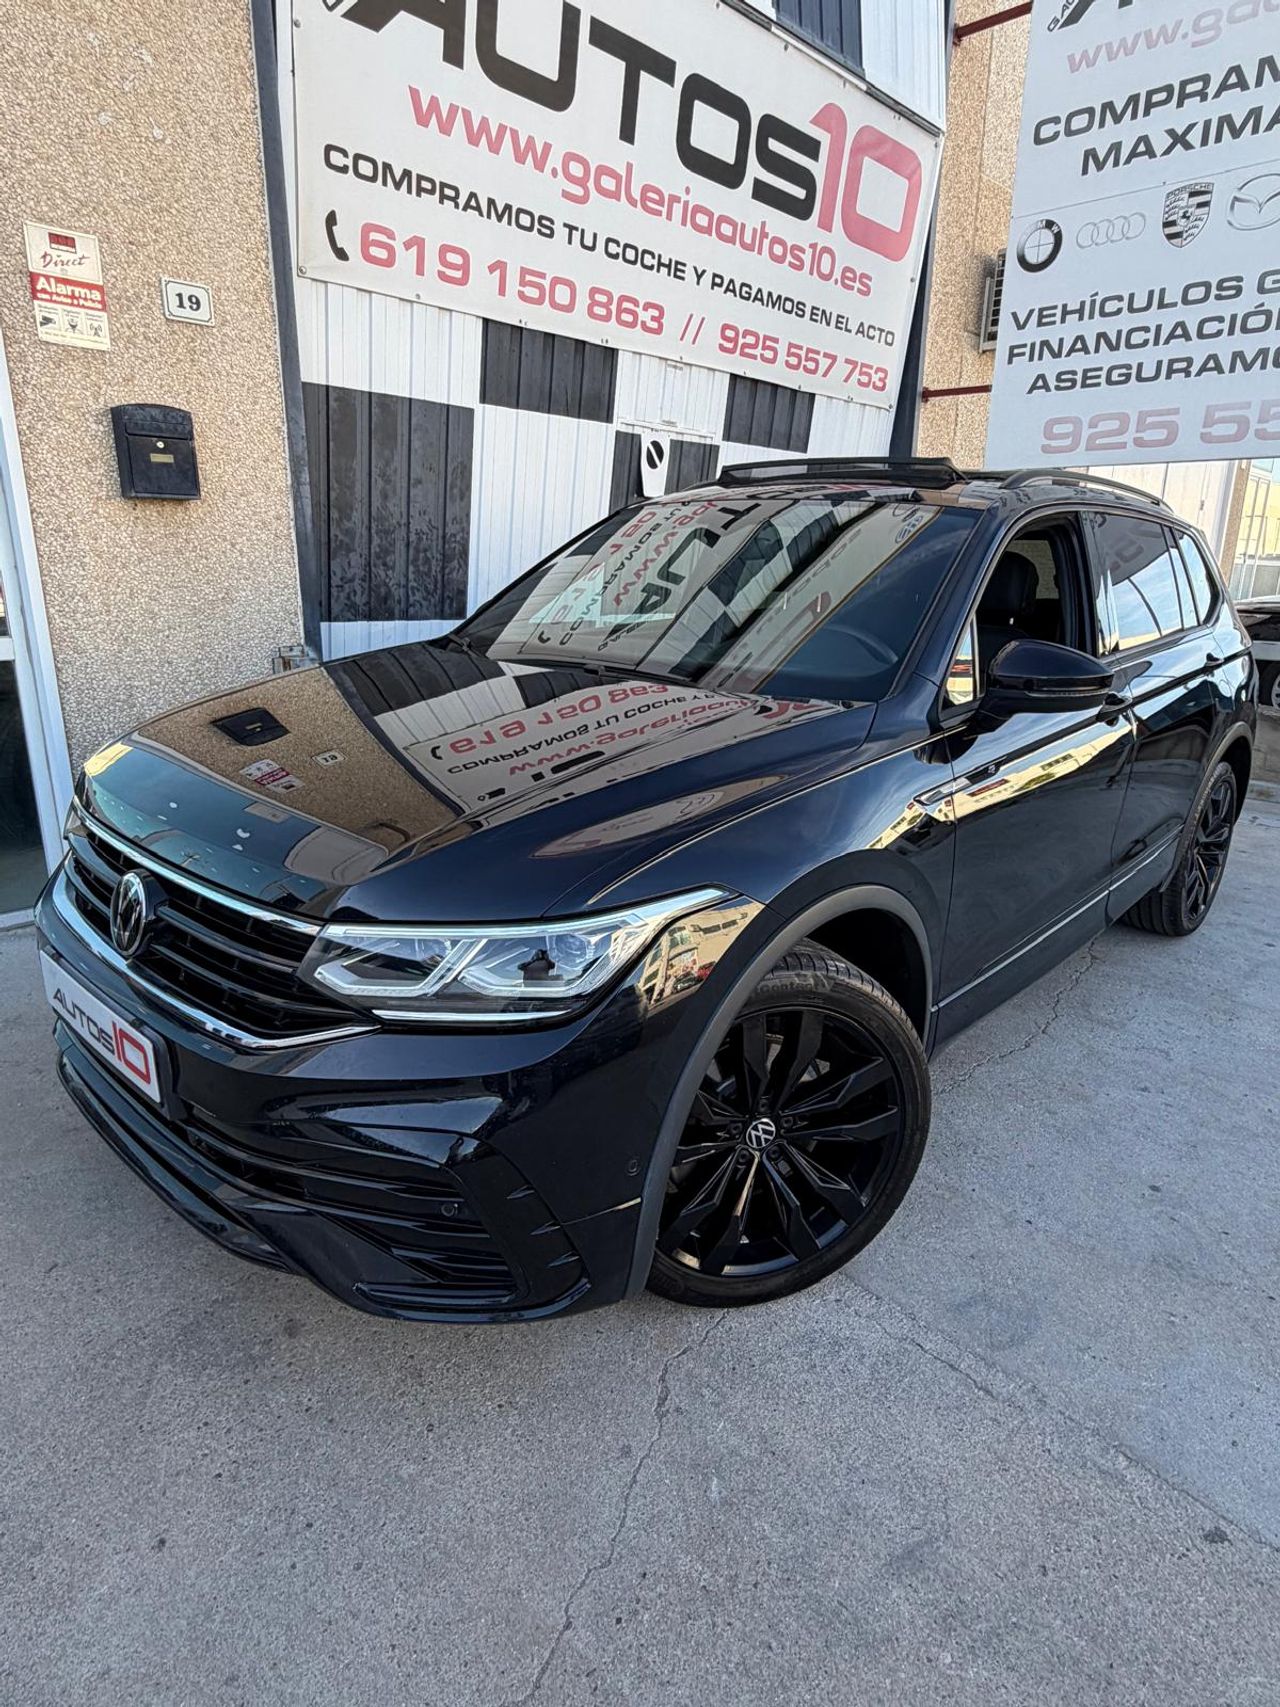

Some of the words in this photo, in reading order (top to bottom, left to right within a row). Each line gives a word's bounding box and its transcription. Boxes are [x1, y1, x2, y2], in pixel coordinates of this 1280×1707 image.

[408, 84, 873, 297] www.galeriaautos10.es
[40, 251, 91, 268] Direct
[323, 144, 555, 239] COMPRAMOS
[563, 222, 598, 252] TU
[604, 237, 687, 281] COCHE
[693, 265, 707, 287] Y
[710, 272, 806, 319] PAGAMOS
[809, 305, 833, 327] EN
[834, 313, 852, 333] EL
[855, 321, 896, 347] ACTO
[36, 276, 102, 300] Alarma
[175, 292, 202, 312] 19
[360, 222, 471, 287] 619
[487, 259, 577, 314] 150
[586, 285, 666, 336] 863
[718, 322, 780, 365] 925
[784, 341, 838, 378] 557
[842, 357, 889, 392] 753
[1011, 275, 1244, 331] VEHÍCULOS
[1007, 302, 1280, 365] FINANCIACIÓ
[1026, 346, 1280, 394] ASEGURAM
[1040, 407, 1180, 454] 925
[53, 987, 151, 1085] AUTOS10
